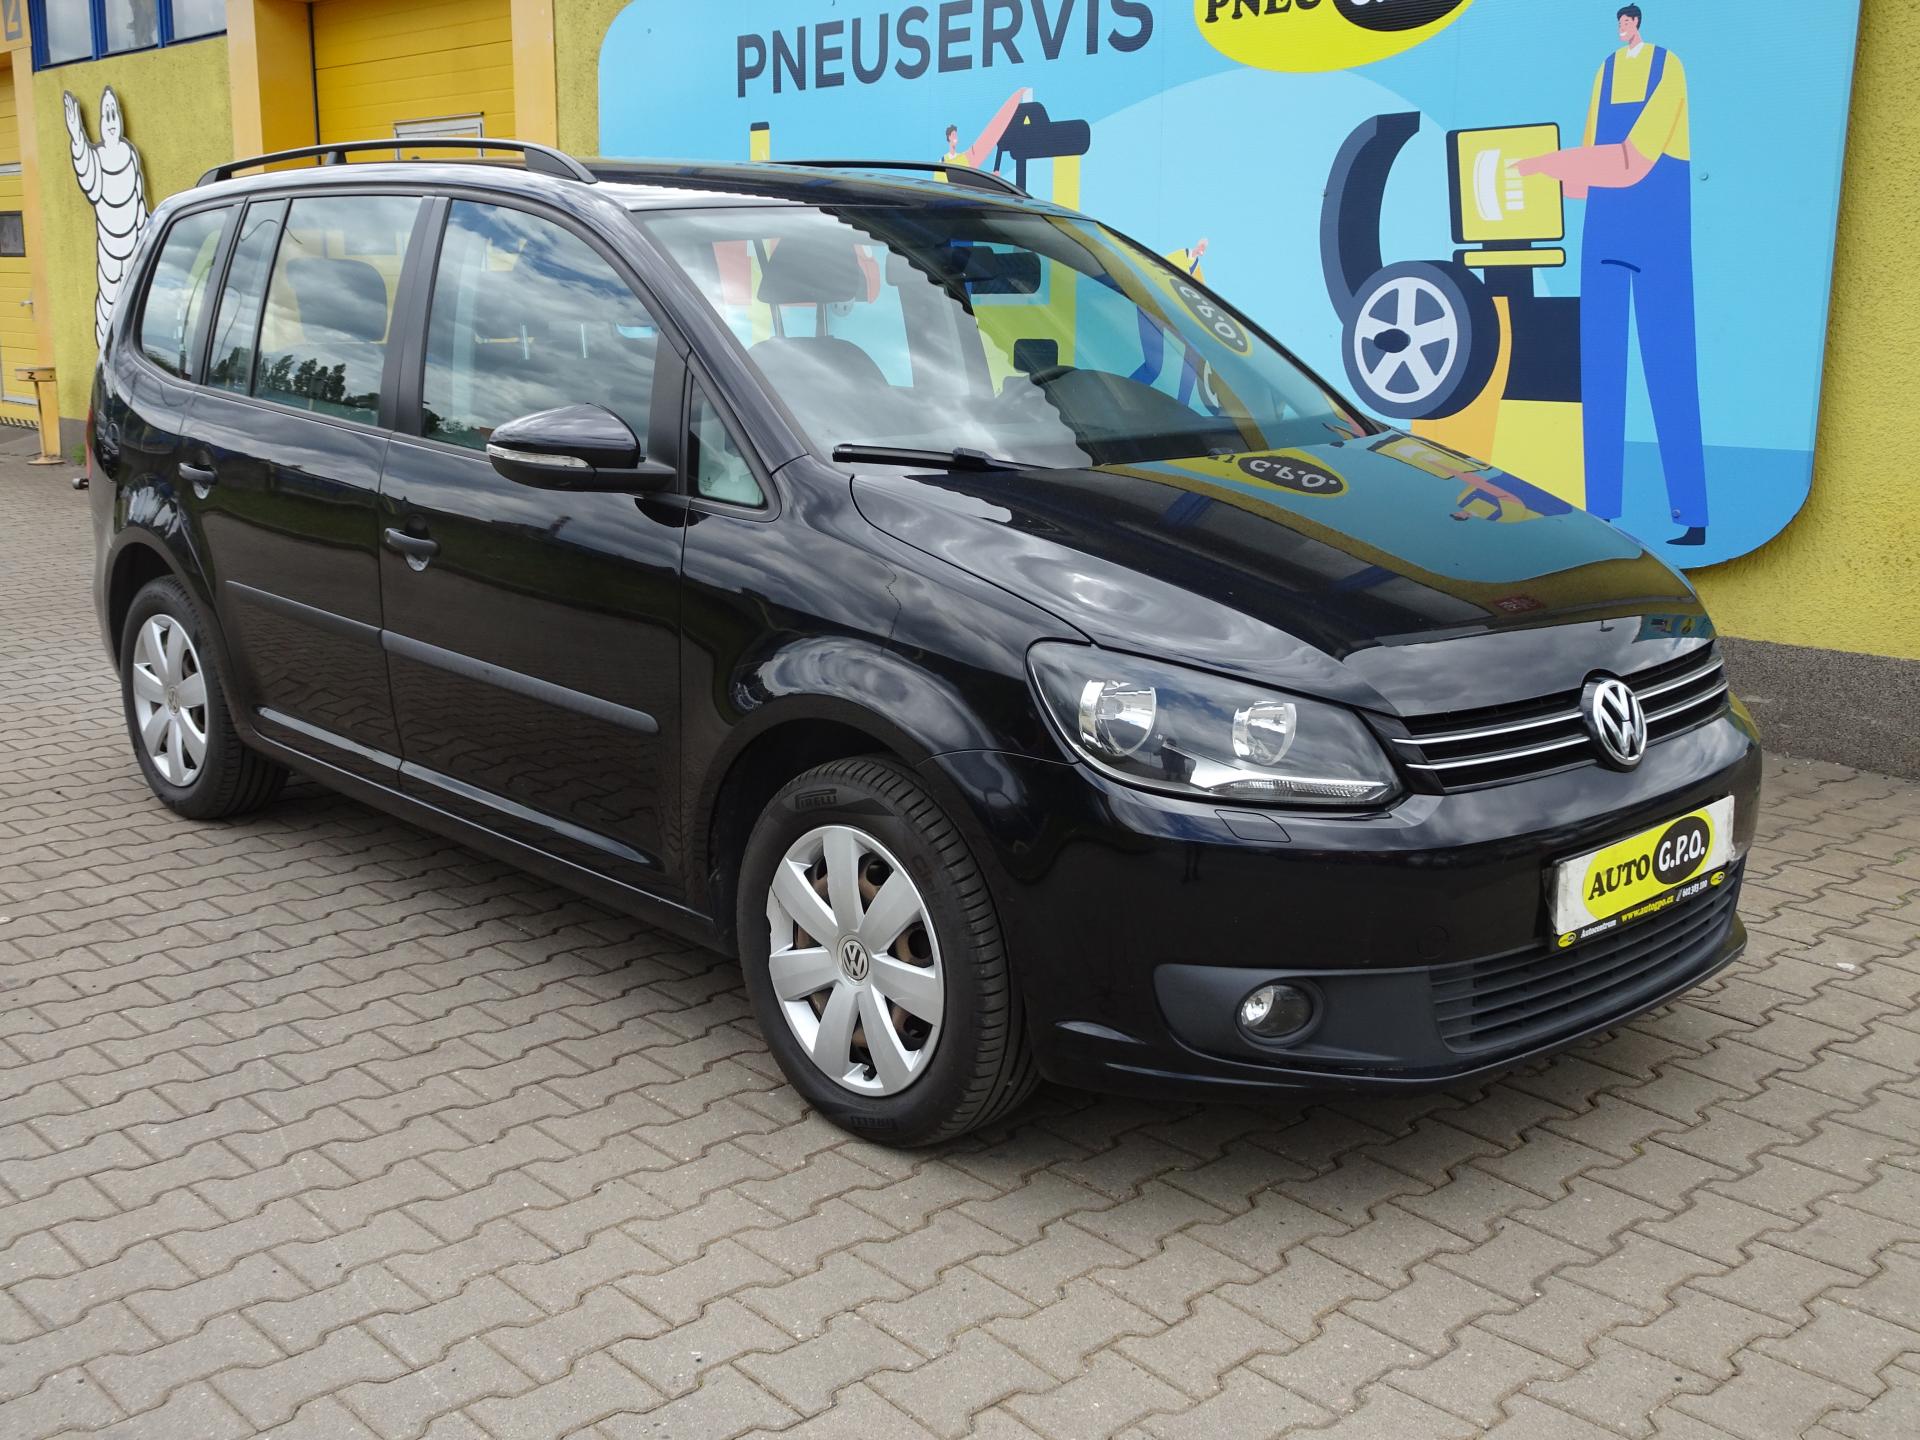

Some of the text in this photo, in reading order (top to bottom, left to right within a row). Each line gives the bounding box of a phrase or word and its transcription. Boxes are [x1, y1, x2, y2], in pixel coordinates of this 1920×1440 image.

[737, 0, 1154, 98] PNEUSERVIS
[1593, 680, 1647, 765] VW
[1588, 830, 1705, 900] AUTO G.P.O.
[841, 939, 869, 981] VW
